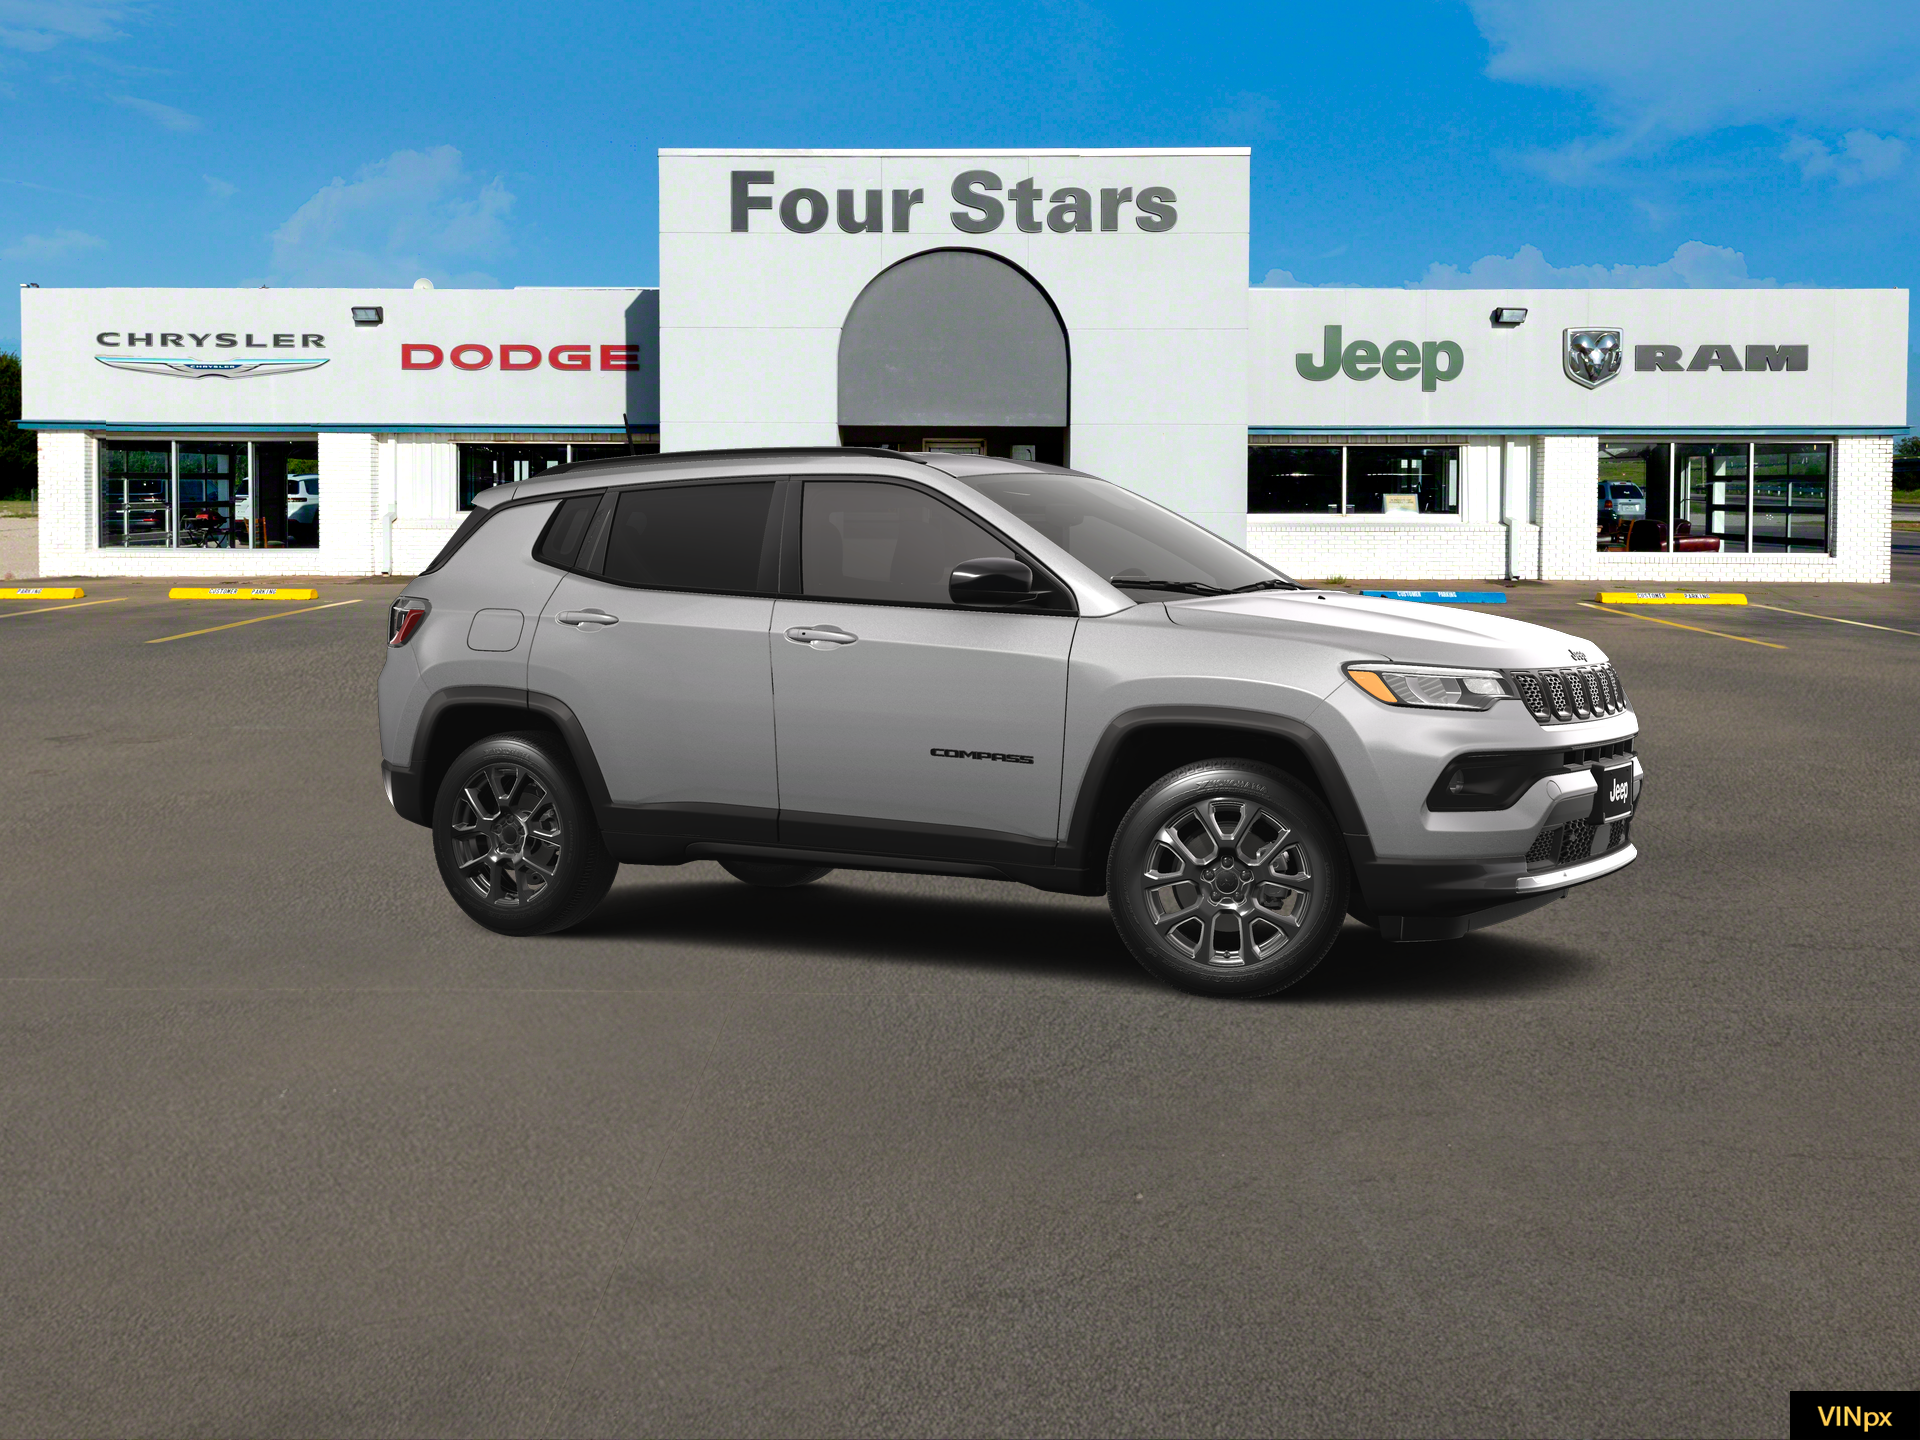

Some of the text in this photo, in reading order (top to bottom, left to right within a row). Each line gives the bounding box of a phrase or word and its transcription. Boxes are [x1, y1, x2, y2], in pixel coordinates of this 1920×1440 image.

[731, 169, 1178, 234] Four Stars
[96, 332, 326, 348] CHRYSLER
[401, 344, 640, 371] DODGE
[1296, 325, 1464, 392] Jeep
[1635, 344, 1809, 372] RAM
[1568, 649, 1588, 663] Jeep
[930, 747, 1035, 765] COMPASS
[1609, 778, 1629, 803] Jeep
